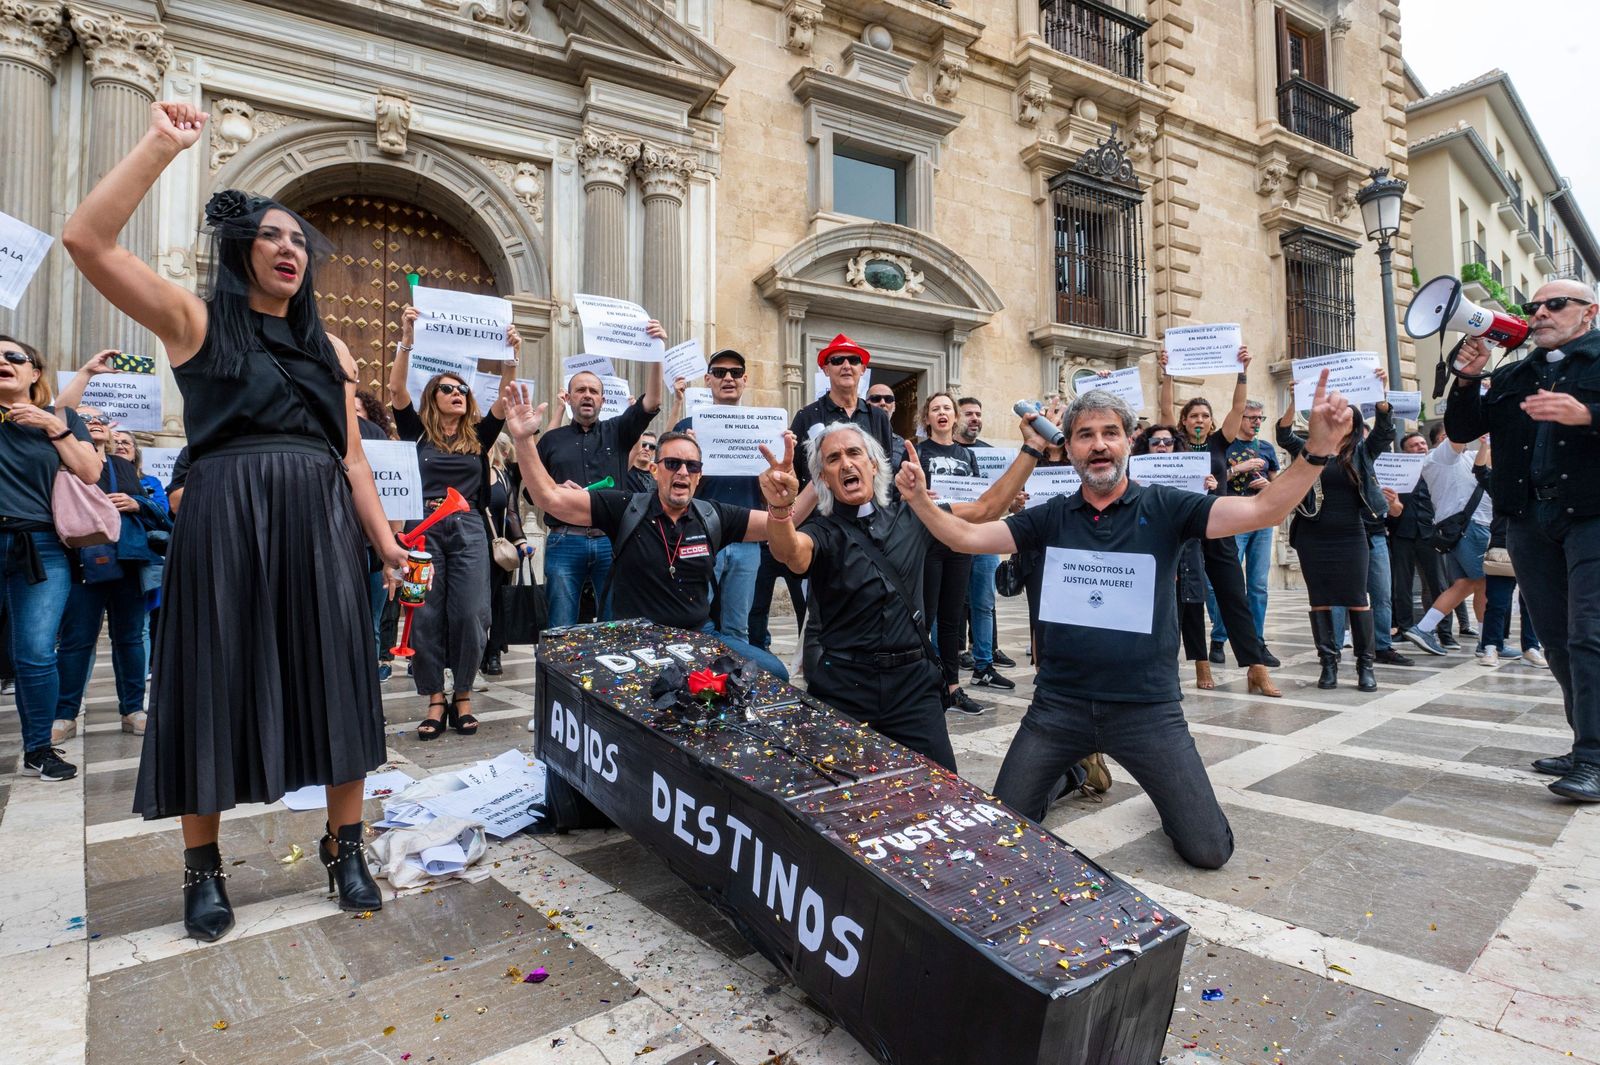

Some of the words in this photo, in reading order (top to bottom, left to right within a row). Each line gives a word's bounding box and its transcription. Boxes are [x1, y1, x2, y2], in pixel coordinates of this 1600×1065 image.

[10, 250, 24, 262] LA
[432, 312, 447, 320] LA
[449, 314, 499, 328] JUSTICIA
[426, 322, 454, 335] ESTÁ
[456, 328, 472, 336] DE
[474, 331, 503, 341] LUTO
[412, 363, 436, 372] JUSTICIA
[423, 356, 454, 368] NOSOTROS
[372, 471, 402, 480] ICIA
[378, 487, 409, 496] UTO
[1063, 562, 1076, 571] SIN
[1078, 563, 1124, 574] NOSOTROS
[1125, 567, 1136, 575] LA
[1063, 576, 1098, 585] JUSTICIA
[1100, 579, 1133, 588] MUERE!
[551, 700, 618, 783] ADIOS
[652, 770, 864, 978] DESTINOS
